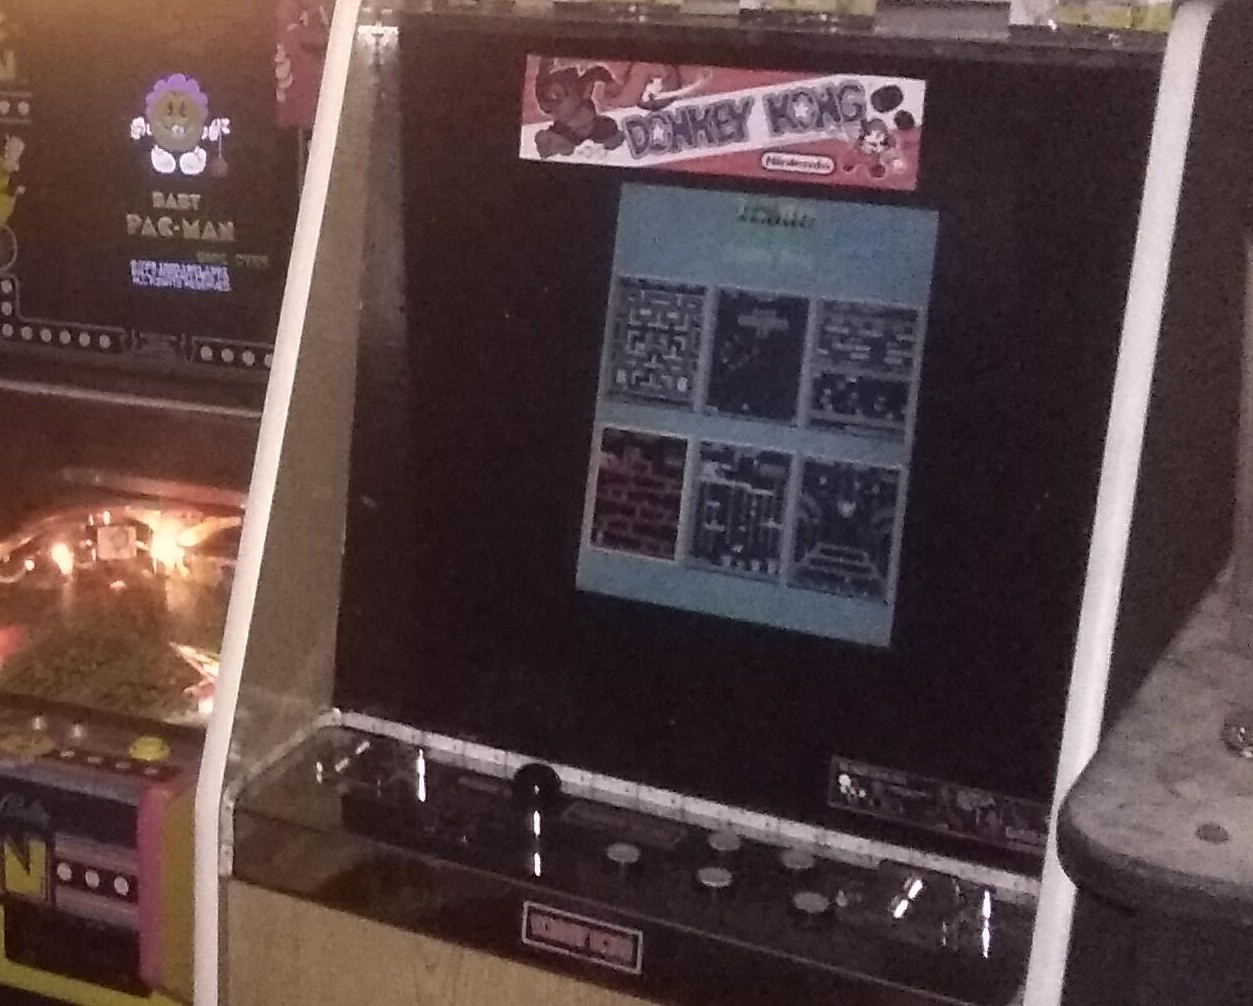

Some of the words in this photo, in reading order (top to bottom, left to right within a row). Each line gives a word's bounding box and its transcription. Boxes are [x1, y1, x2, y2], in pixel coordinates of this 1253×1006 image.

[622, 95, 754, 160] DONKEY
[762, 80, 866, 137] KONG
[152, 191, 201, 211] BABY
